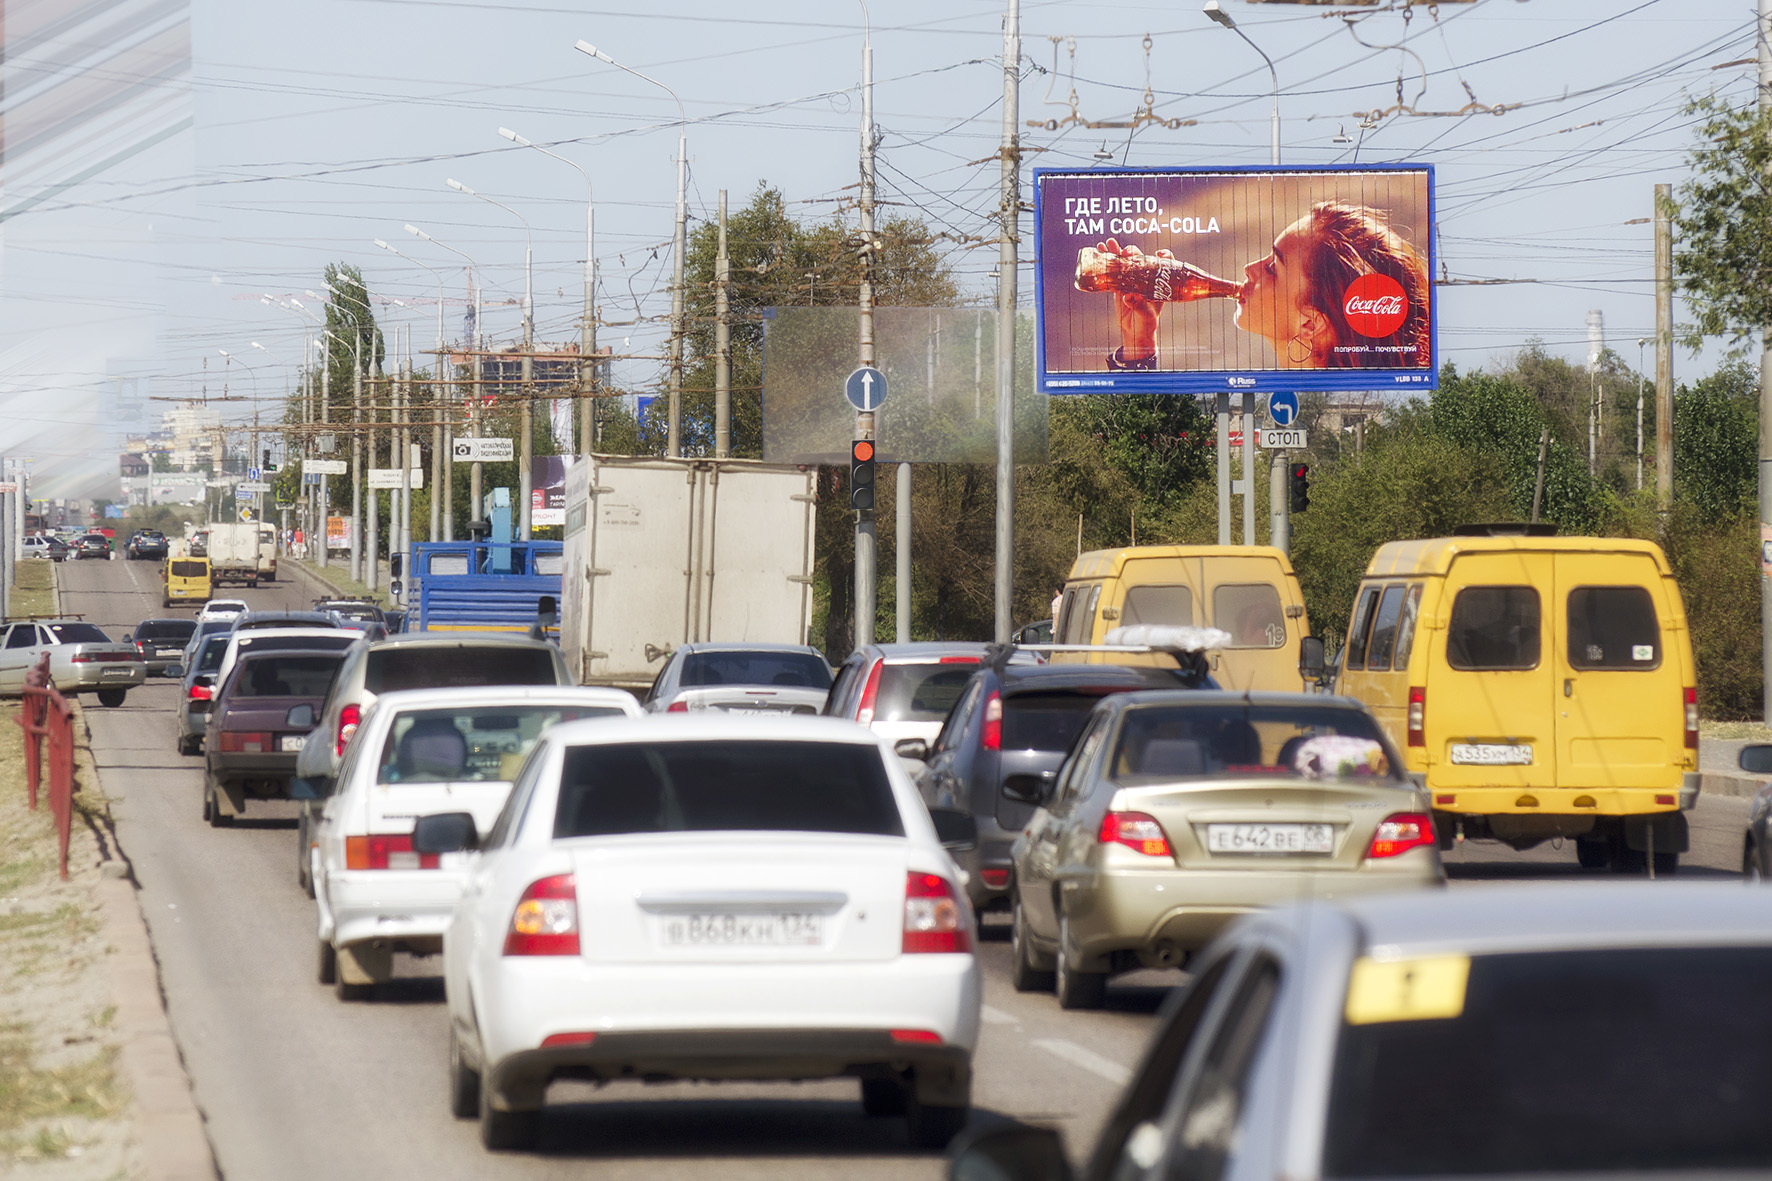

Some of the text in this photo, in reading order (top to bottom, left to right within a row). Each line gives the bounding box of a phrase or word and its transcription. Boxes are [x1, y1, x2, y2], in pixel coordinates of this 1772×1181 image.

[1065, 197, 1164, 218] ГДЕ ЛЕТО,
[1064, 217, 1220, 235] ТАМ COCA-COLA
[1345, 295, 1405, 315] Coca-Cola
[1375, 344, 1417, 353] ПОЧУВСТВУЙ
[1267, 431, 1300, 445] СТОП
